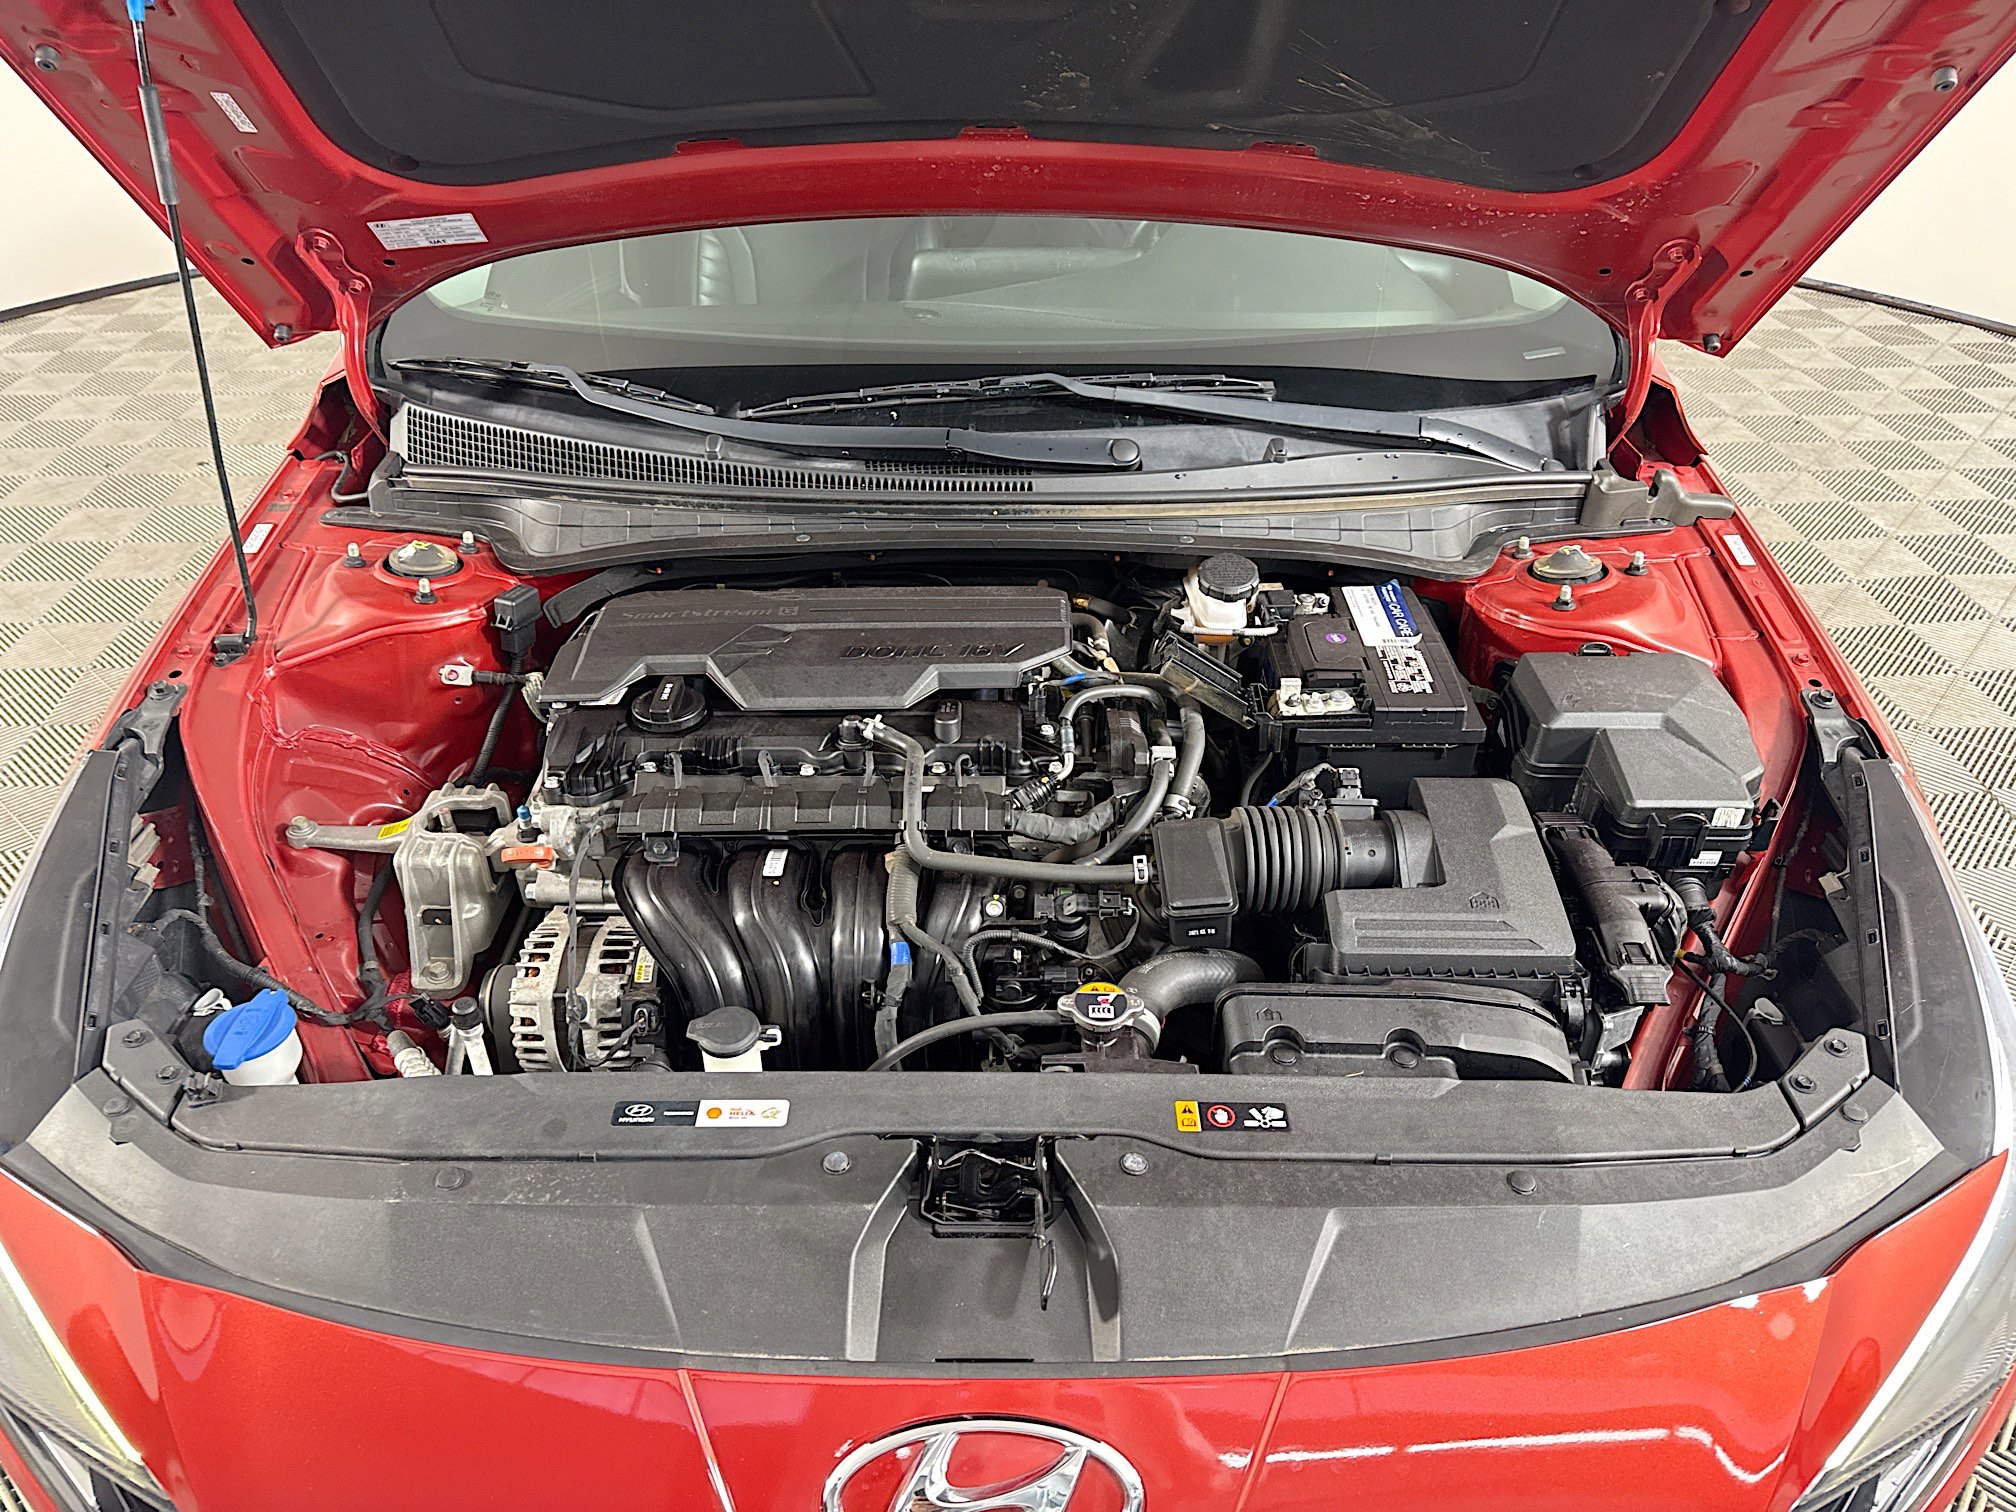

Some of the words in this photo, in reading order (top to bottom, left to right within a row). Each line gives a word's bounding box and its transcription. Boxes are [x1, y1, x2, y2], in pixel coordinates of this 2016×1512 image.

[622, 608, 773, 620] Smartstream
[1388, 603, 1405, 618] CAR
[1395, 618, 1413, 637] CARE
[839, 643, 952, 660] DOHC
[958, 642, 1025, 658] 16V
